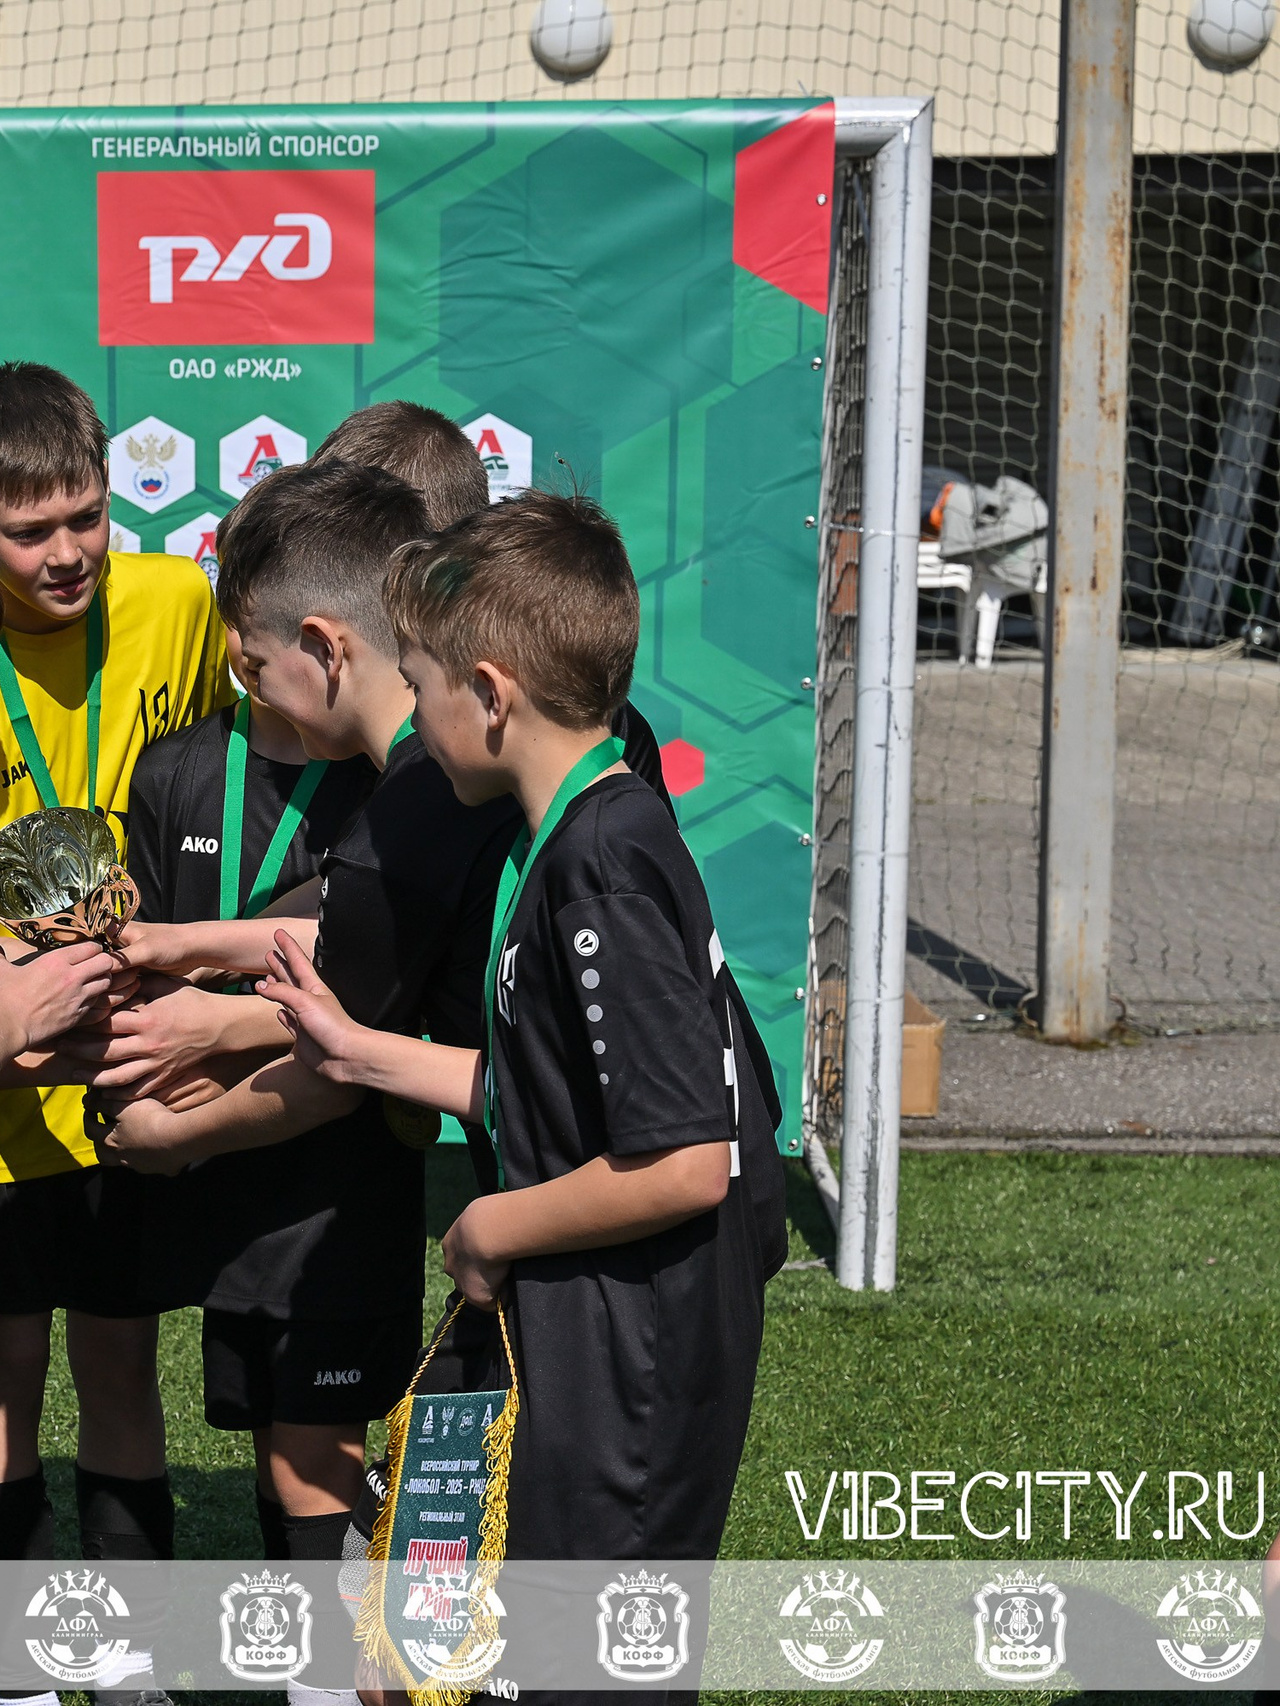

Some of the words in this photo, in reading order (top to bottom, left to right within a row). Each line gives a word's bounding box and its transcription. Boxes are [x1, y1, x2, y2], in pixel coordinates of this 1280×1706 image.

[91, 131, 261, 158] ГЕНЕРАЛЬНЫЙ
[269, 134, 380, 157] СПОНСОР
[169, 358, 216, 379] ОАО
[224, 358, 302, 381] «РЖД»
[1, 757, 46, 789] JAK
[181, 835, 219, 854] AKO
[313, 1368, 362, 1386] JAKO
[446, 1478, 463, 1495] 2025
[403, 1536, 469, 1577] ЛУЧШИЙ
